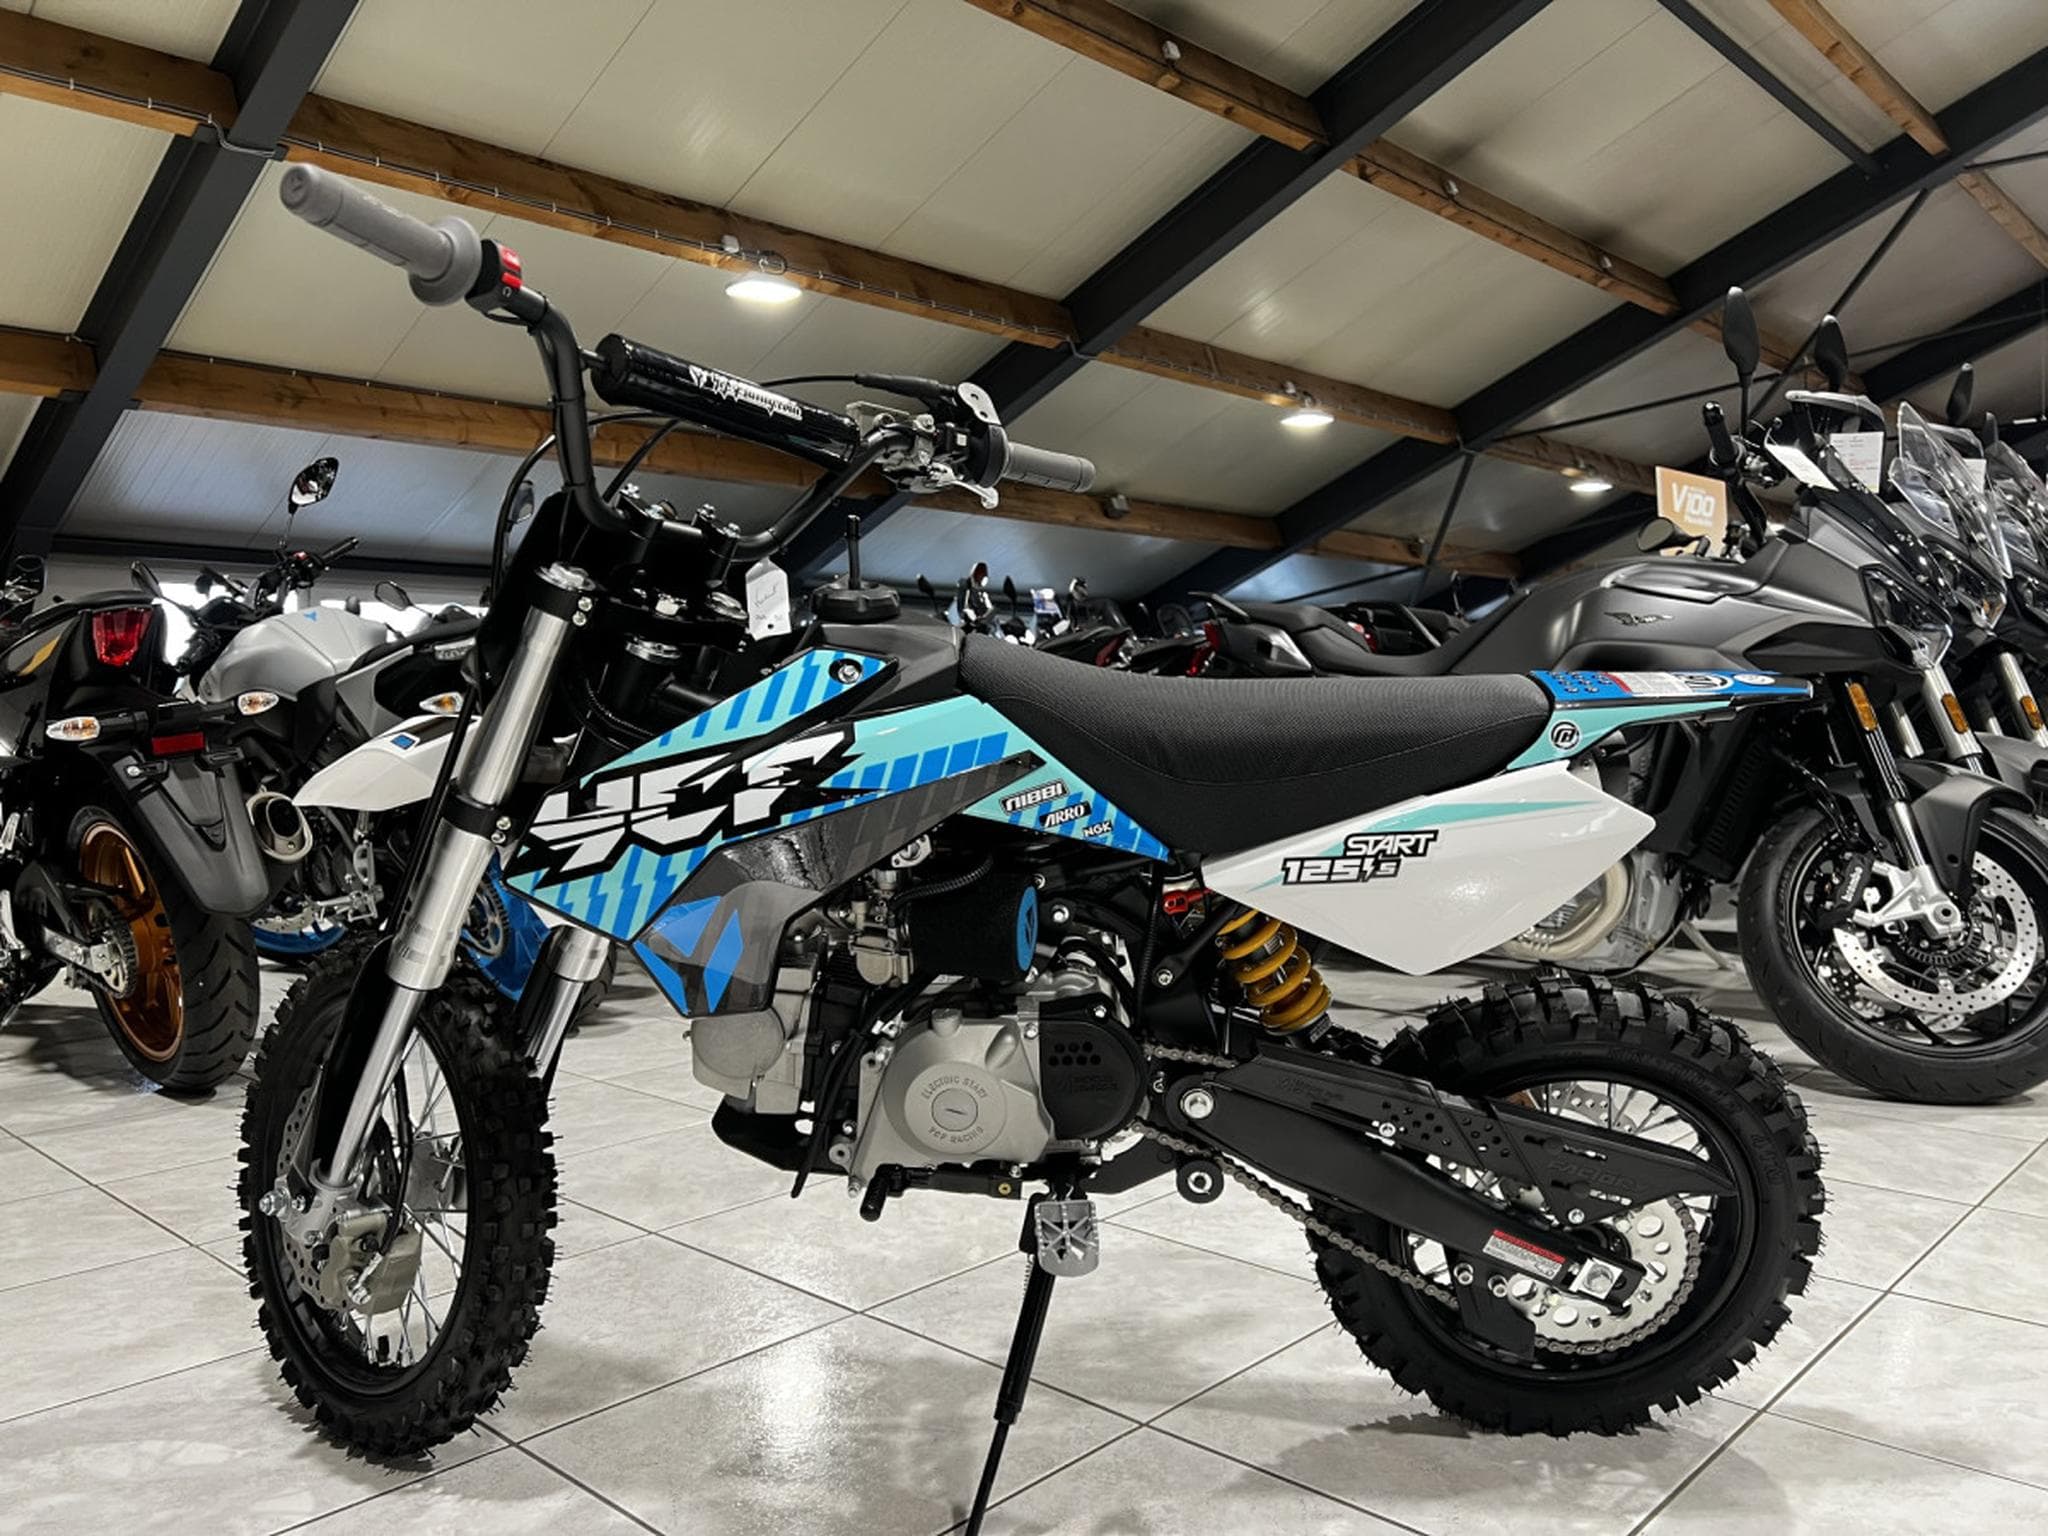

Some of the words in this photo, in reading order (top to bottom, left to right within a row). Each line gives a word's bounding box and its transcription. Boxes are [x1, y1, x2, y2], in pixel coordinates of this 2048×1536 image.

[1083, 822, 1112, 838] NGK
[1345, 832, 1435, 857] START
[962, 1078, 989, 1099] START
